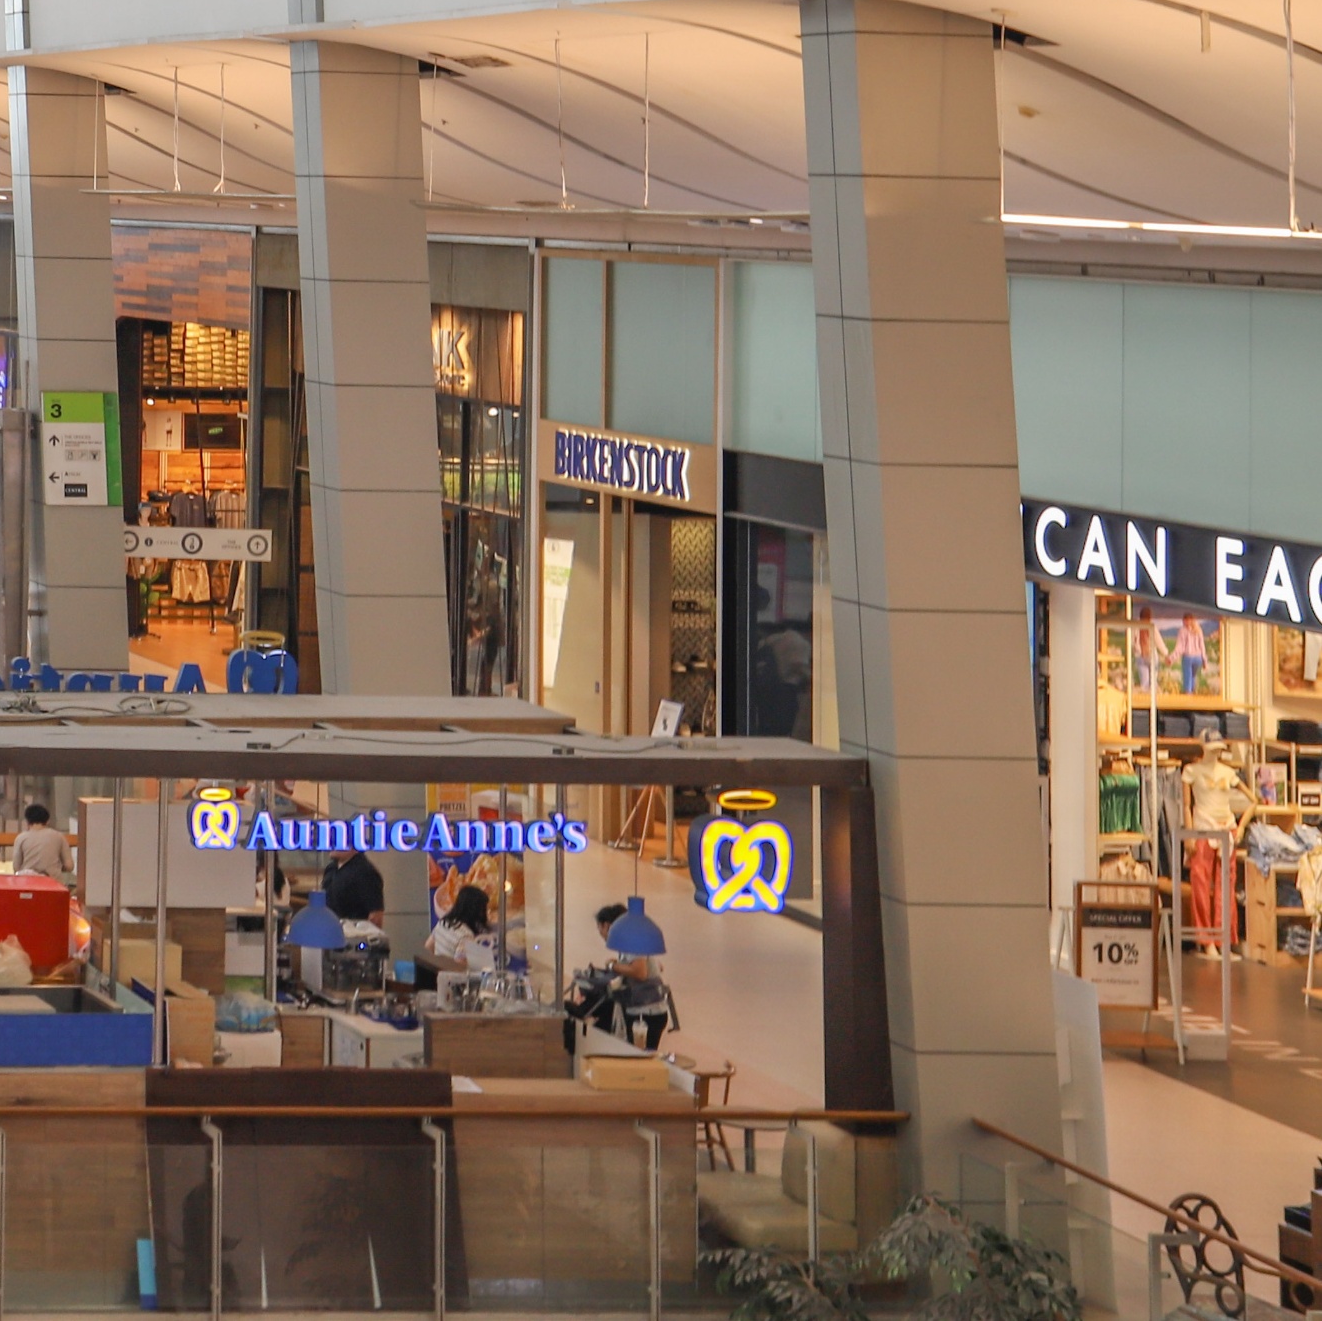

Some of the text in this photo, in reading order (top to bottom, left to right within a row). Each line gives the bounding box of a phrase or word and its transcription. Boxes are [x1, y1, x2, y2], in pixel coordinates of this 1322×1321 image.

[50, 403, 62, 418] 3
[555, 428, 690, 502] BIRKENSTOCK
[1021, 503, 1168, 598] CAN
[246, 810, 589, 853] Auntie Anne's
[1089, 914, 1142, 923] SPECIAL OFFER
[1093, 943, 1139, 964] 10%
